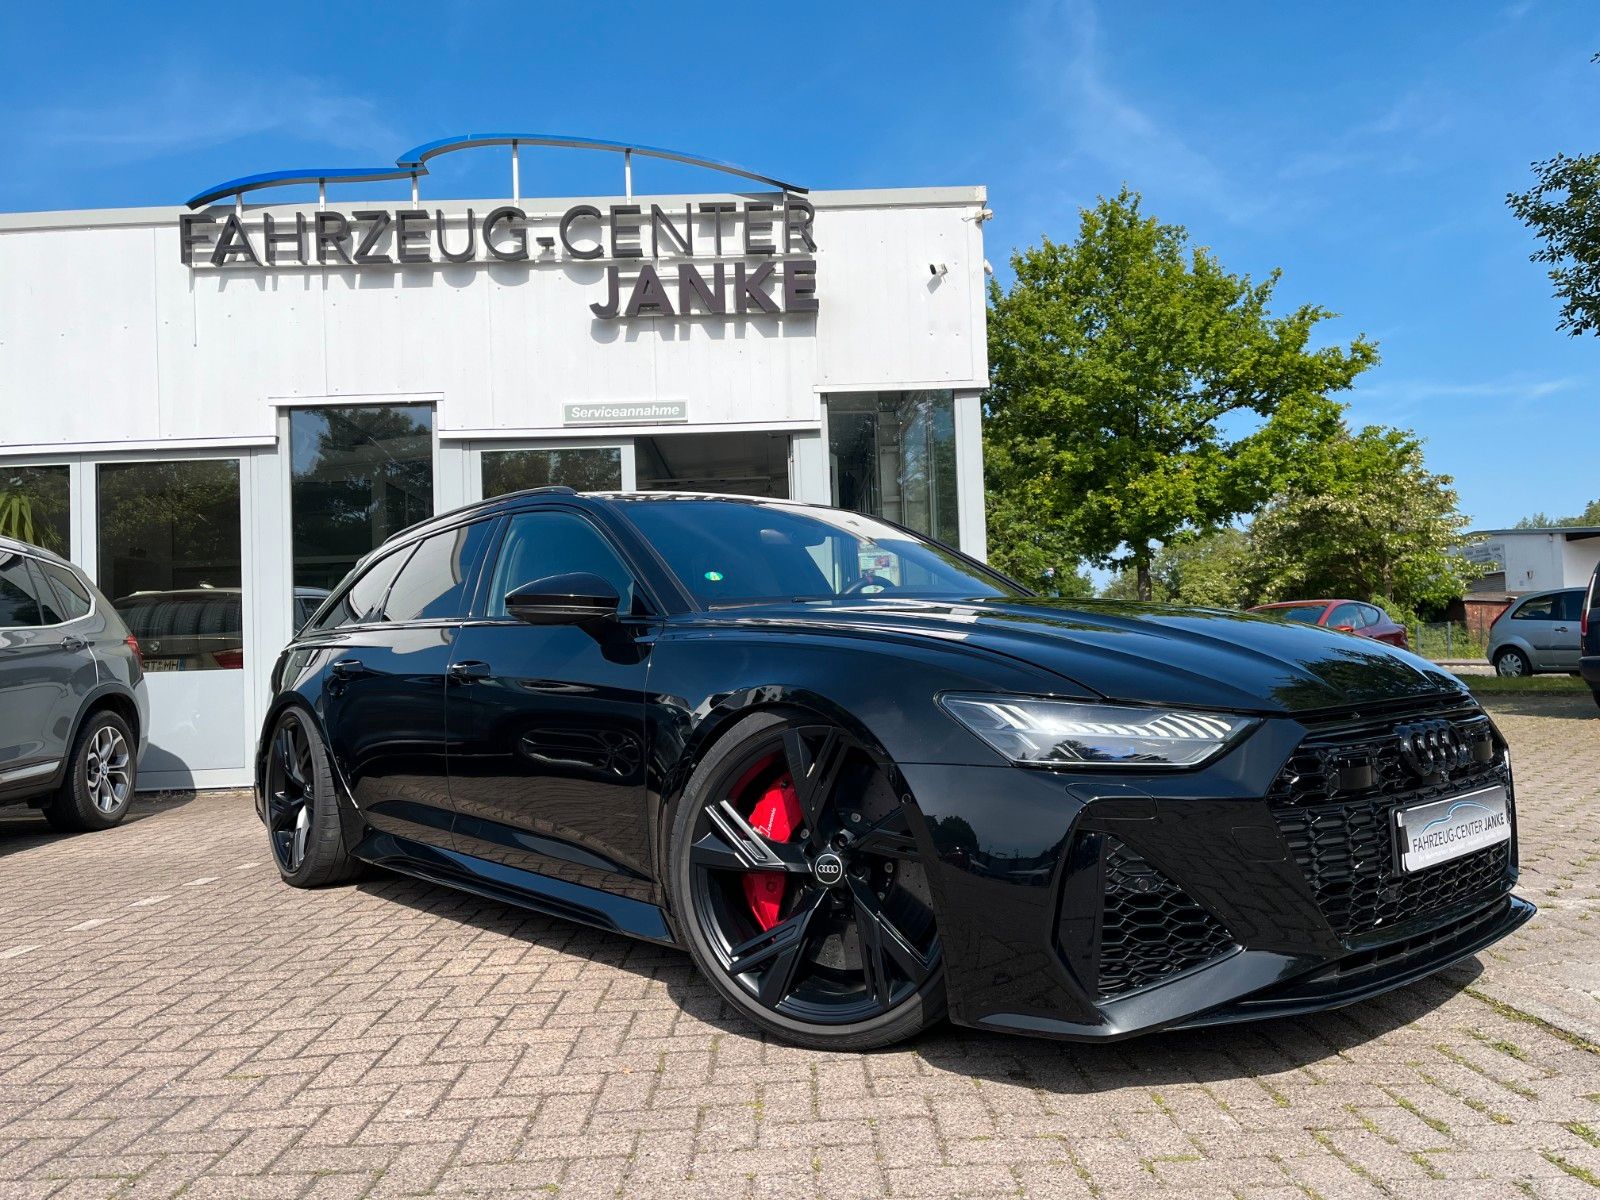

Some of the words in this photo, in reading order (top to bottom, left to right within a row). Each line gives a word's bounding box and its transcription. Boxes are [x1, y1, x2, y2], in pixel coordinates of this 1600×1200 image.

[179, 202, 817, 268] FAHRZEUG-CENTER
[589, 260, 820, 319] JANKE
[571, 405, 680, 418] Serviceannahme
[1412, 819, 1484, 853] FAHRZEUG-CENTER
[1484, 812, 1505, 831] JANKE
